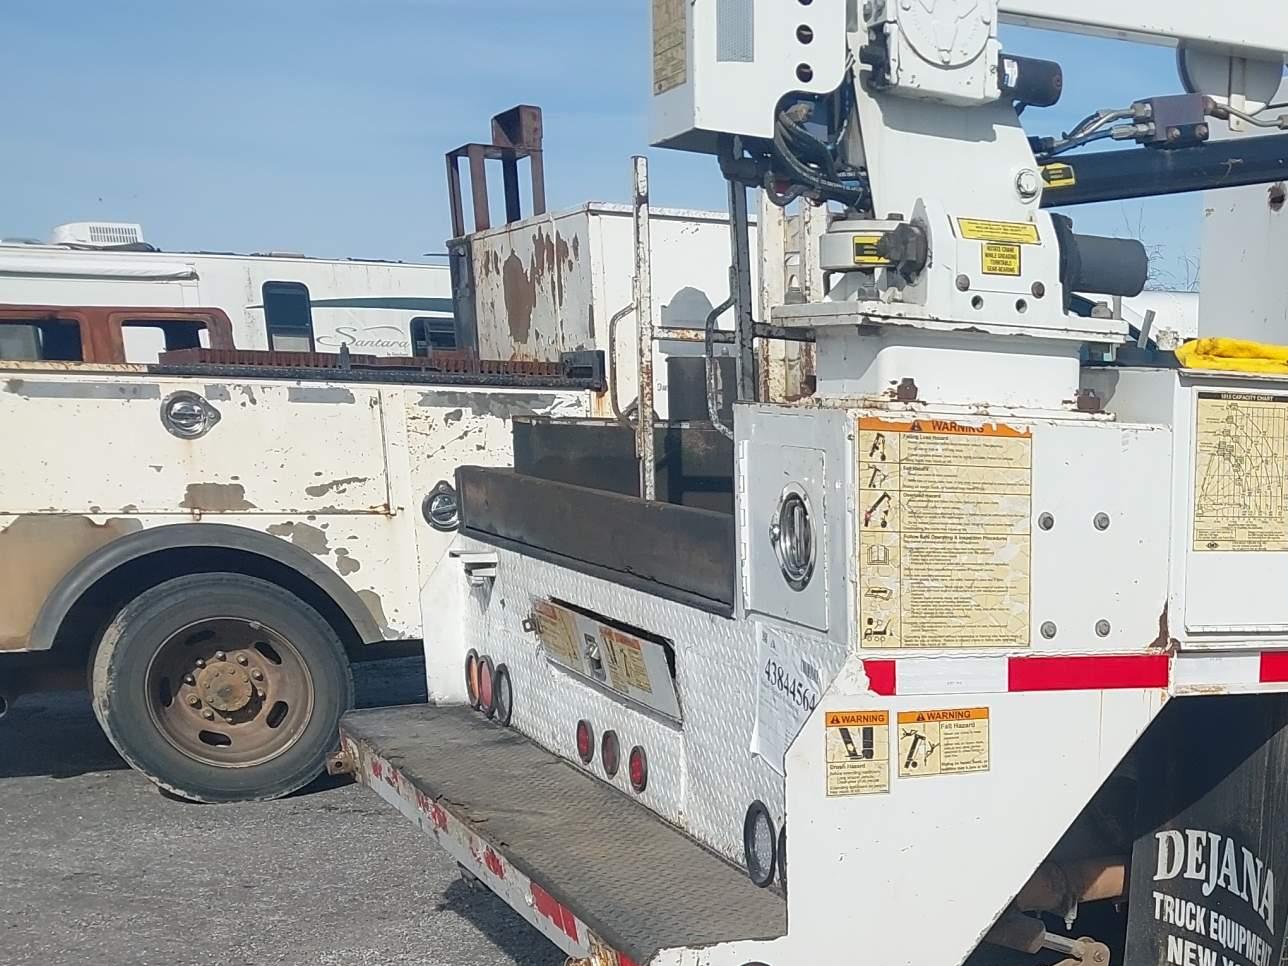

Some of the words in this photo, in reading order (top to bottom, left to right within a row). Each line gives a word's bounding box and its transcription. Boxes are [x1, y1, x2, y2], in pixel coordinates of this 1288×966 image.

[765, 658, 815, 711] 43844564
[841, 715, 885, 724] WARNING
[926, 711, 971, 720] WARNING
[1153, 829, 1275, 935] DEJANA
[1152, 891, 1206, 936] TRUCK
